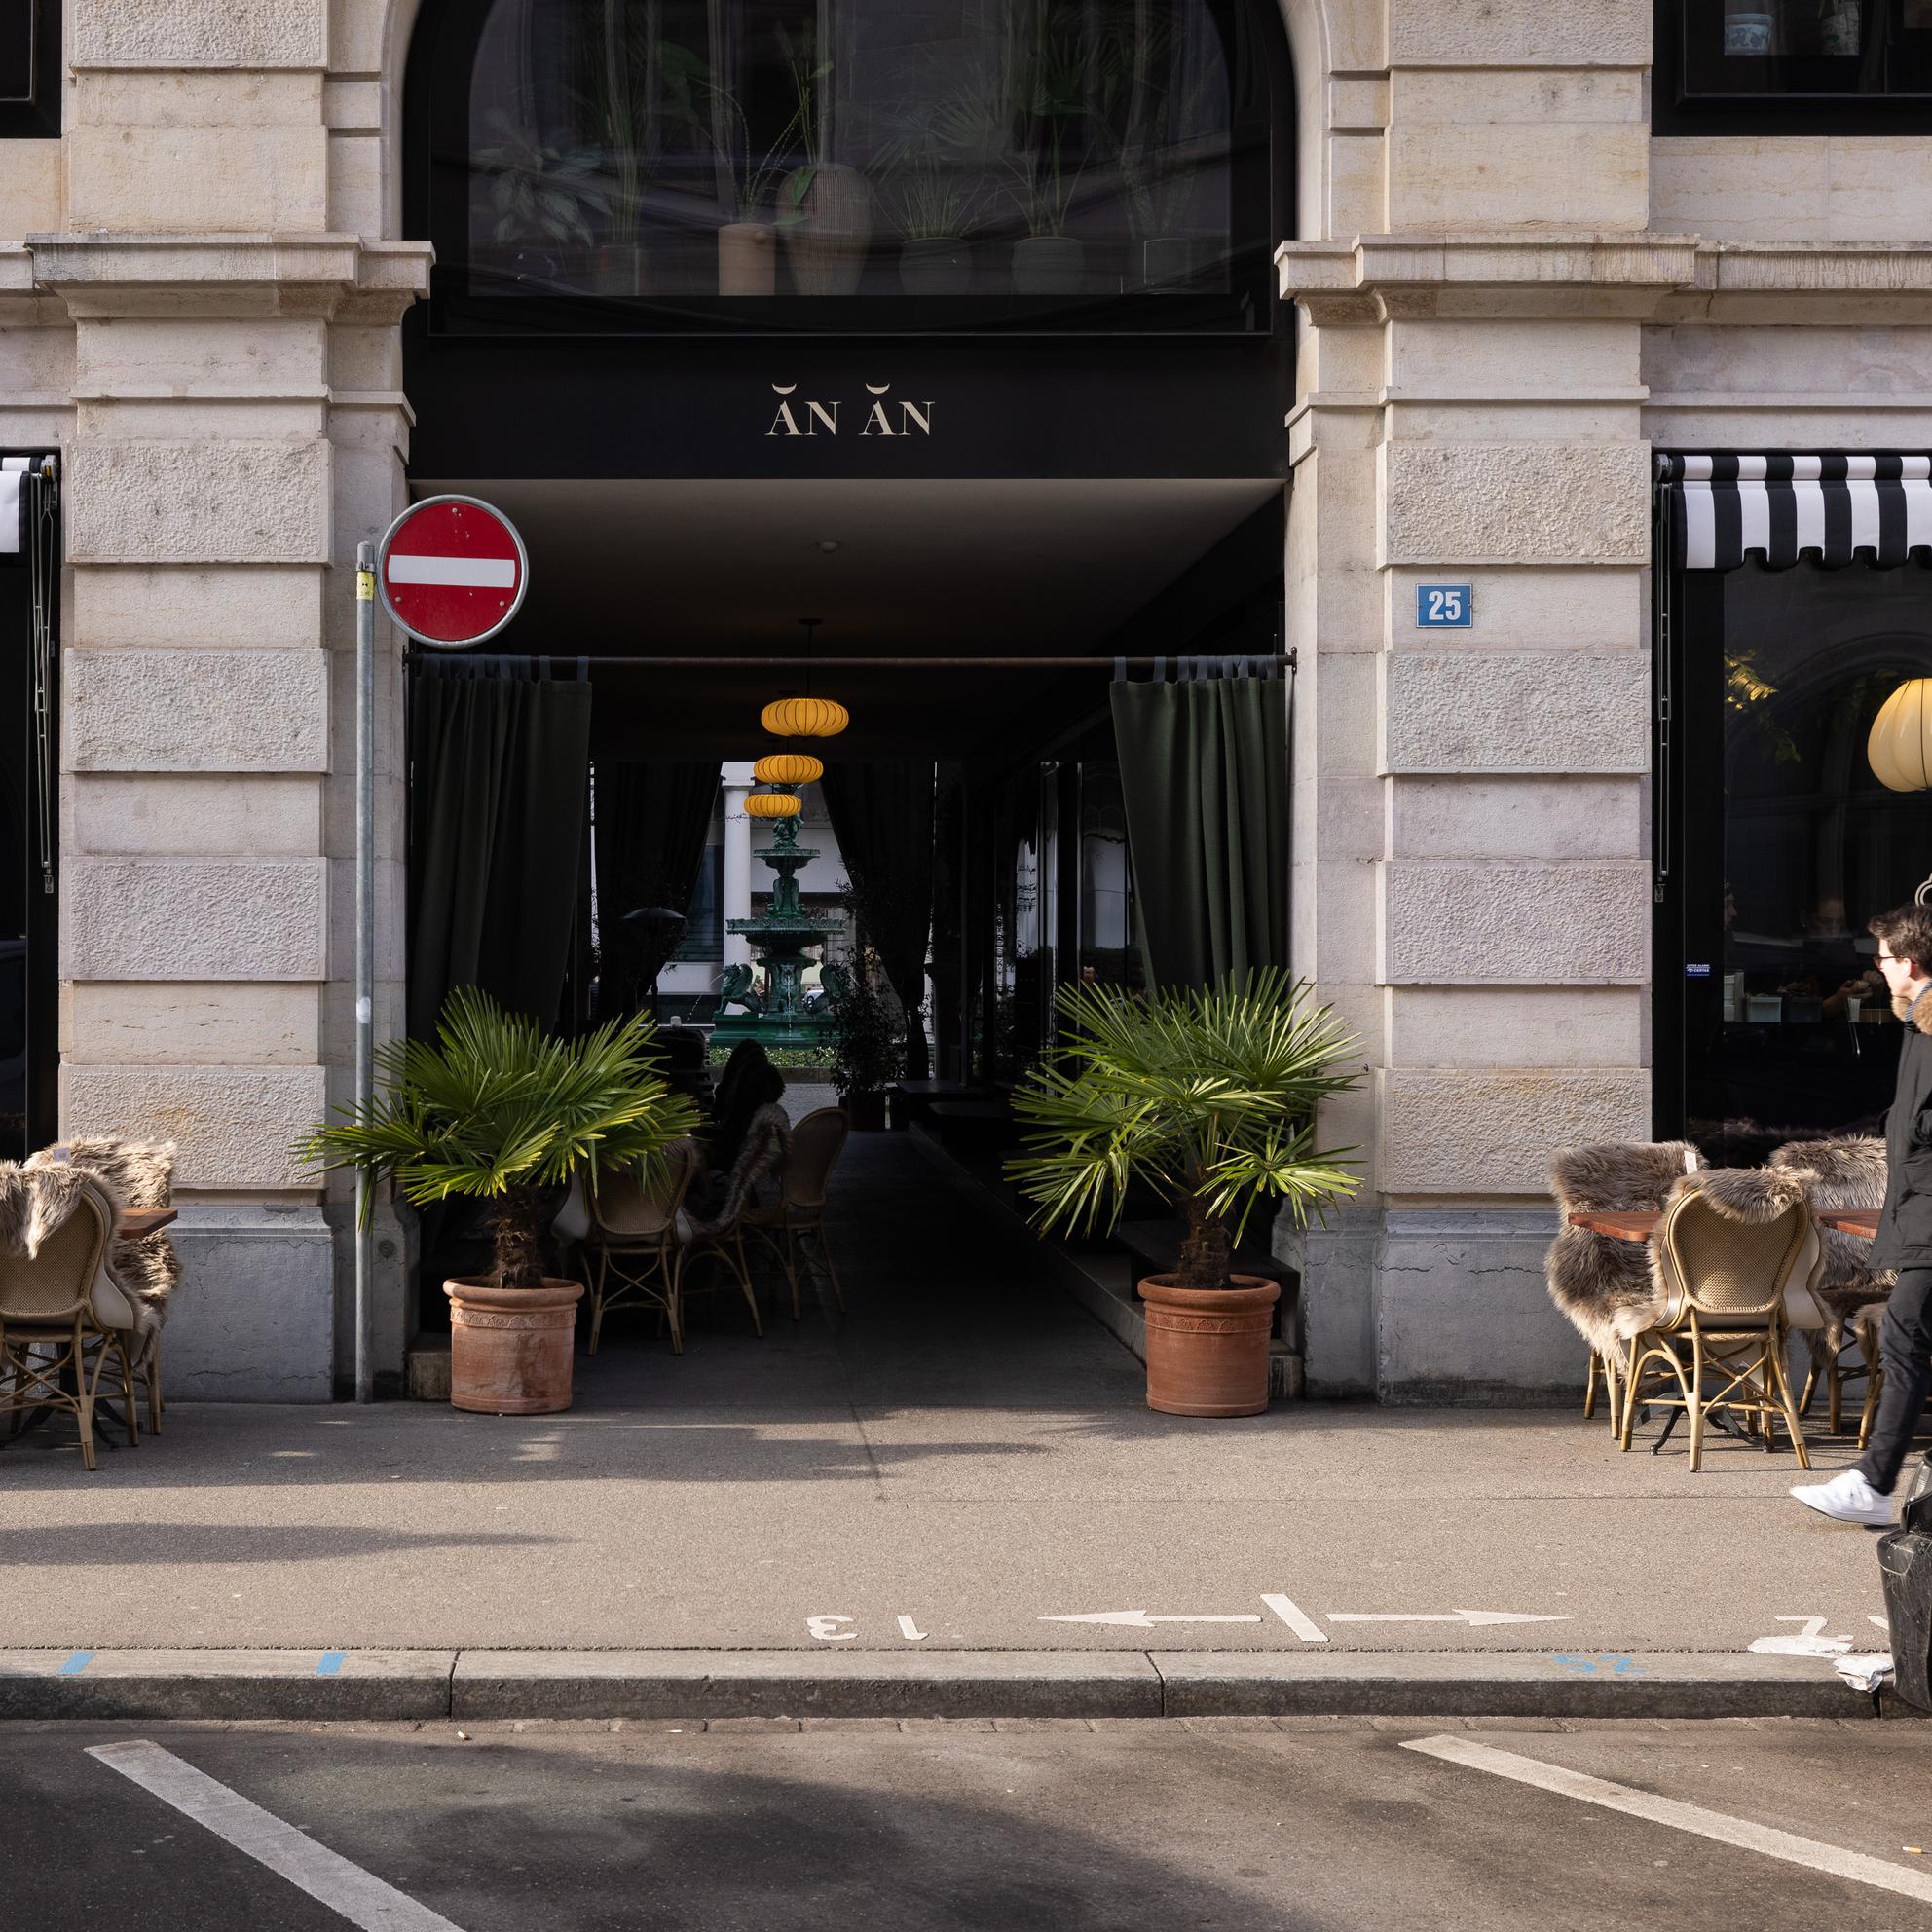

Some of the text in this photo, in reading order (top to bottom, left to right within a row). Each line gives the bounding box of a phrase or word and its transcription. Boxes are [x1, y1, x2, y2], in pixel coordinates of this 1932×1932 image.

[764, 382, 935, 436] ĂN ĂN
[1428, 590, 1461, 620] 25
